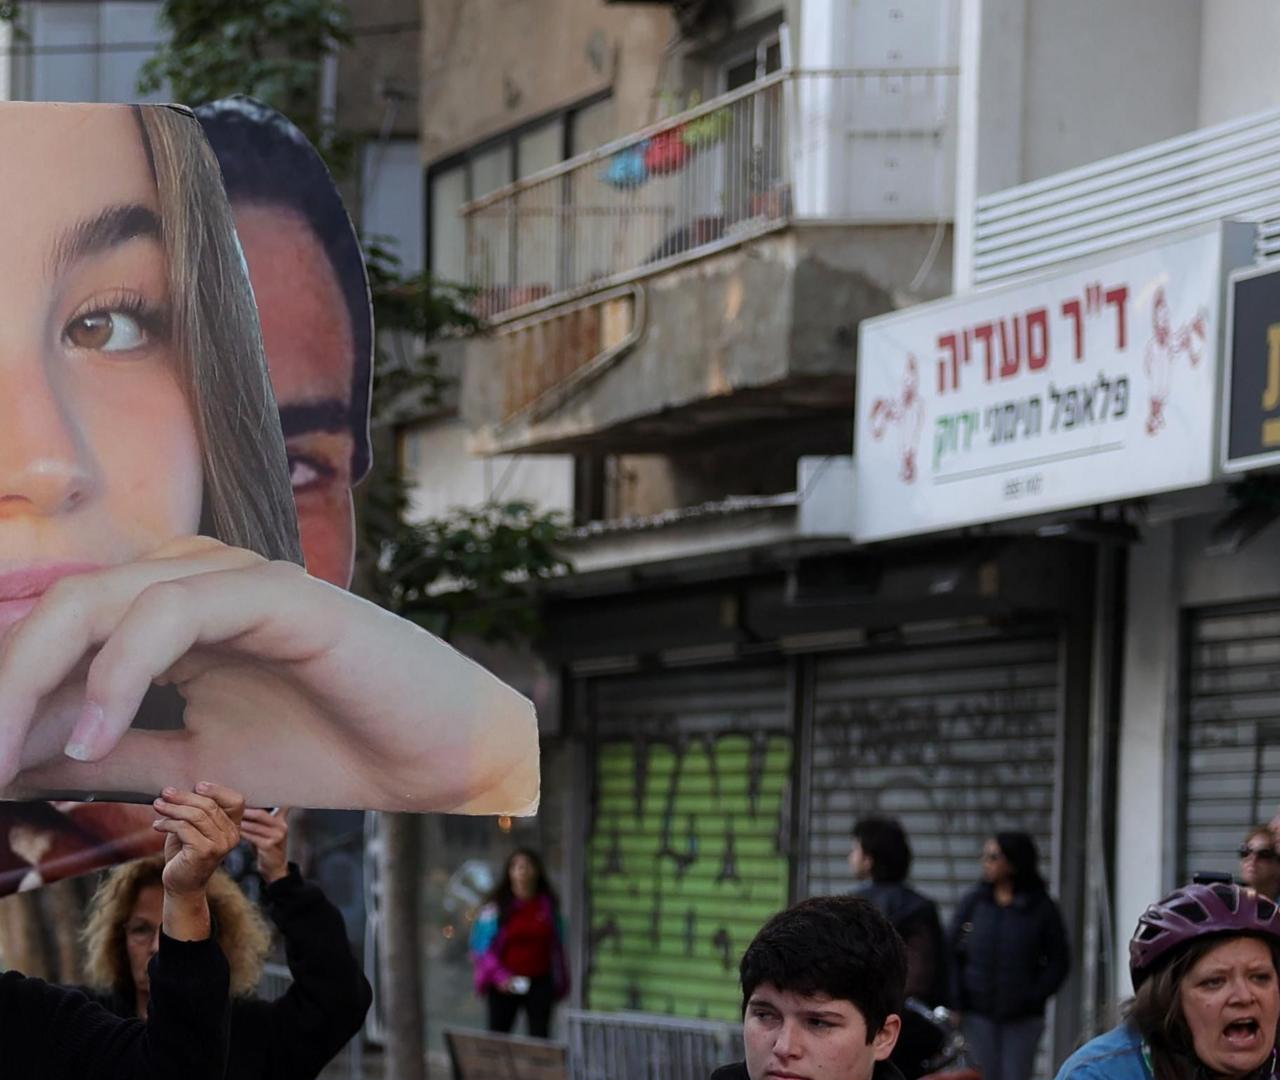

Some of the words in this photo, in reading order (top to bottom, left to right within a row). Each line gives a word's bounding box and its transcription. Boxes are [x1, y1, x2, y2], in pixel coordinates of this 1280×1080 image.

[937, 308, 1048, 396] סעדיה
[1062, 280, 1128, 360] ד"ר
[1048, 372, 1130, 431] פלאפל
[932, 410, 980, 474] ירוק
